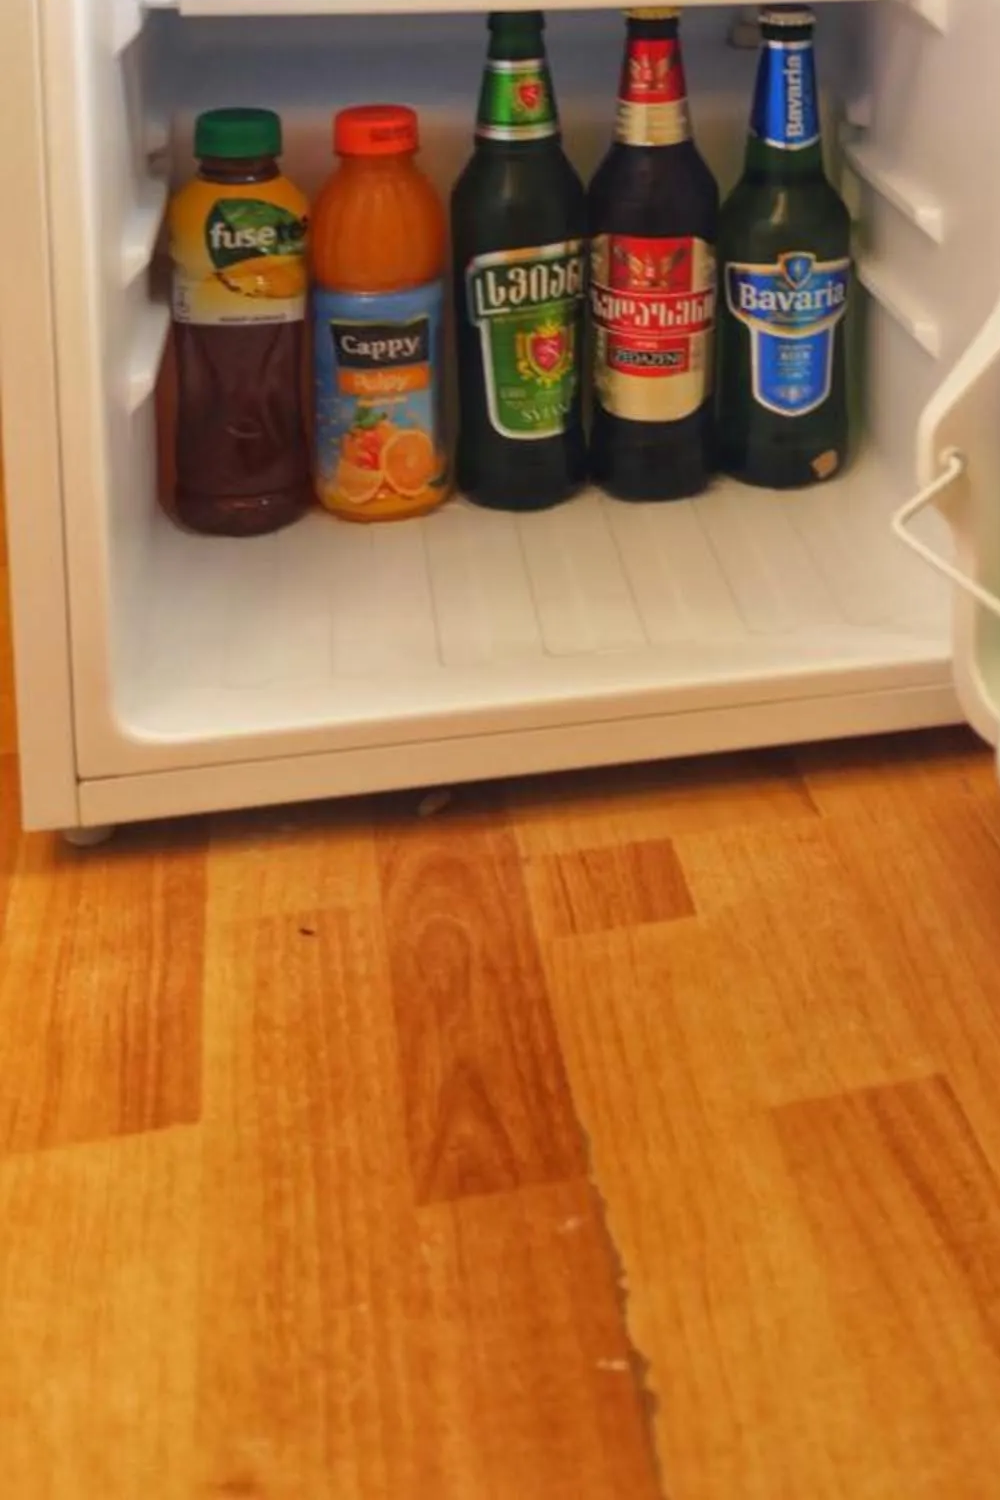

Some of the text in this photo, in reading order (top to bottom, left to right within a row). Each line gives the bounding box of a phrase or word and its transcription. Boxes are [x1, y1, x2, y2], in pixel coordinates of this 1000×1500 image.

[785, 54, 804, 137] Bavaria
[738, 279, 845, 312] Bavaria
[341, 334, 421, 360] Cappy
